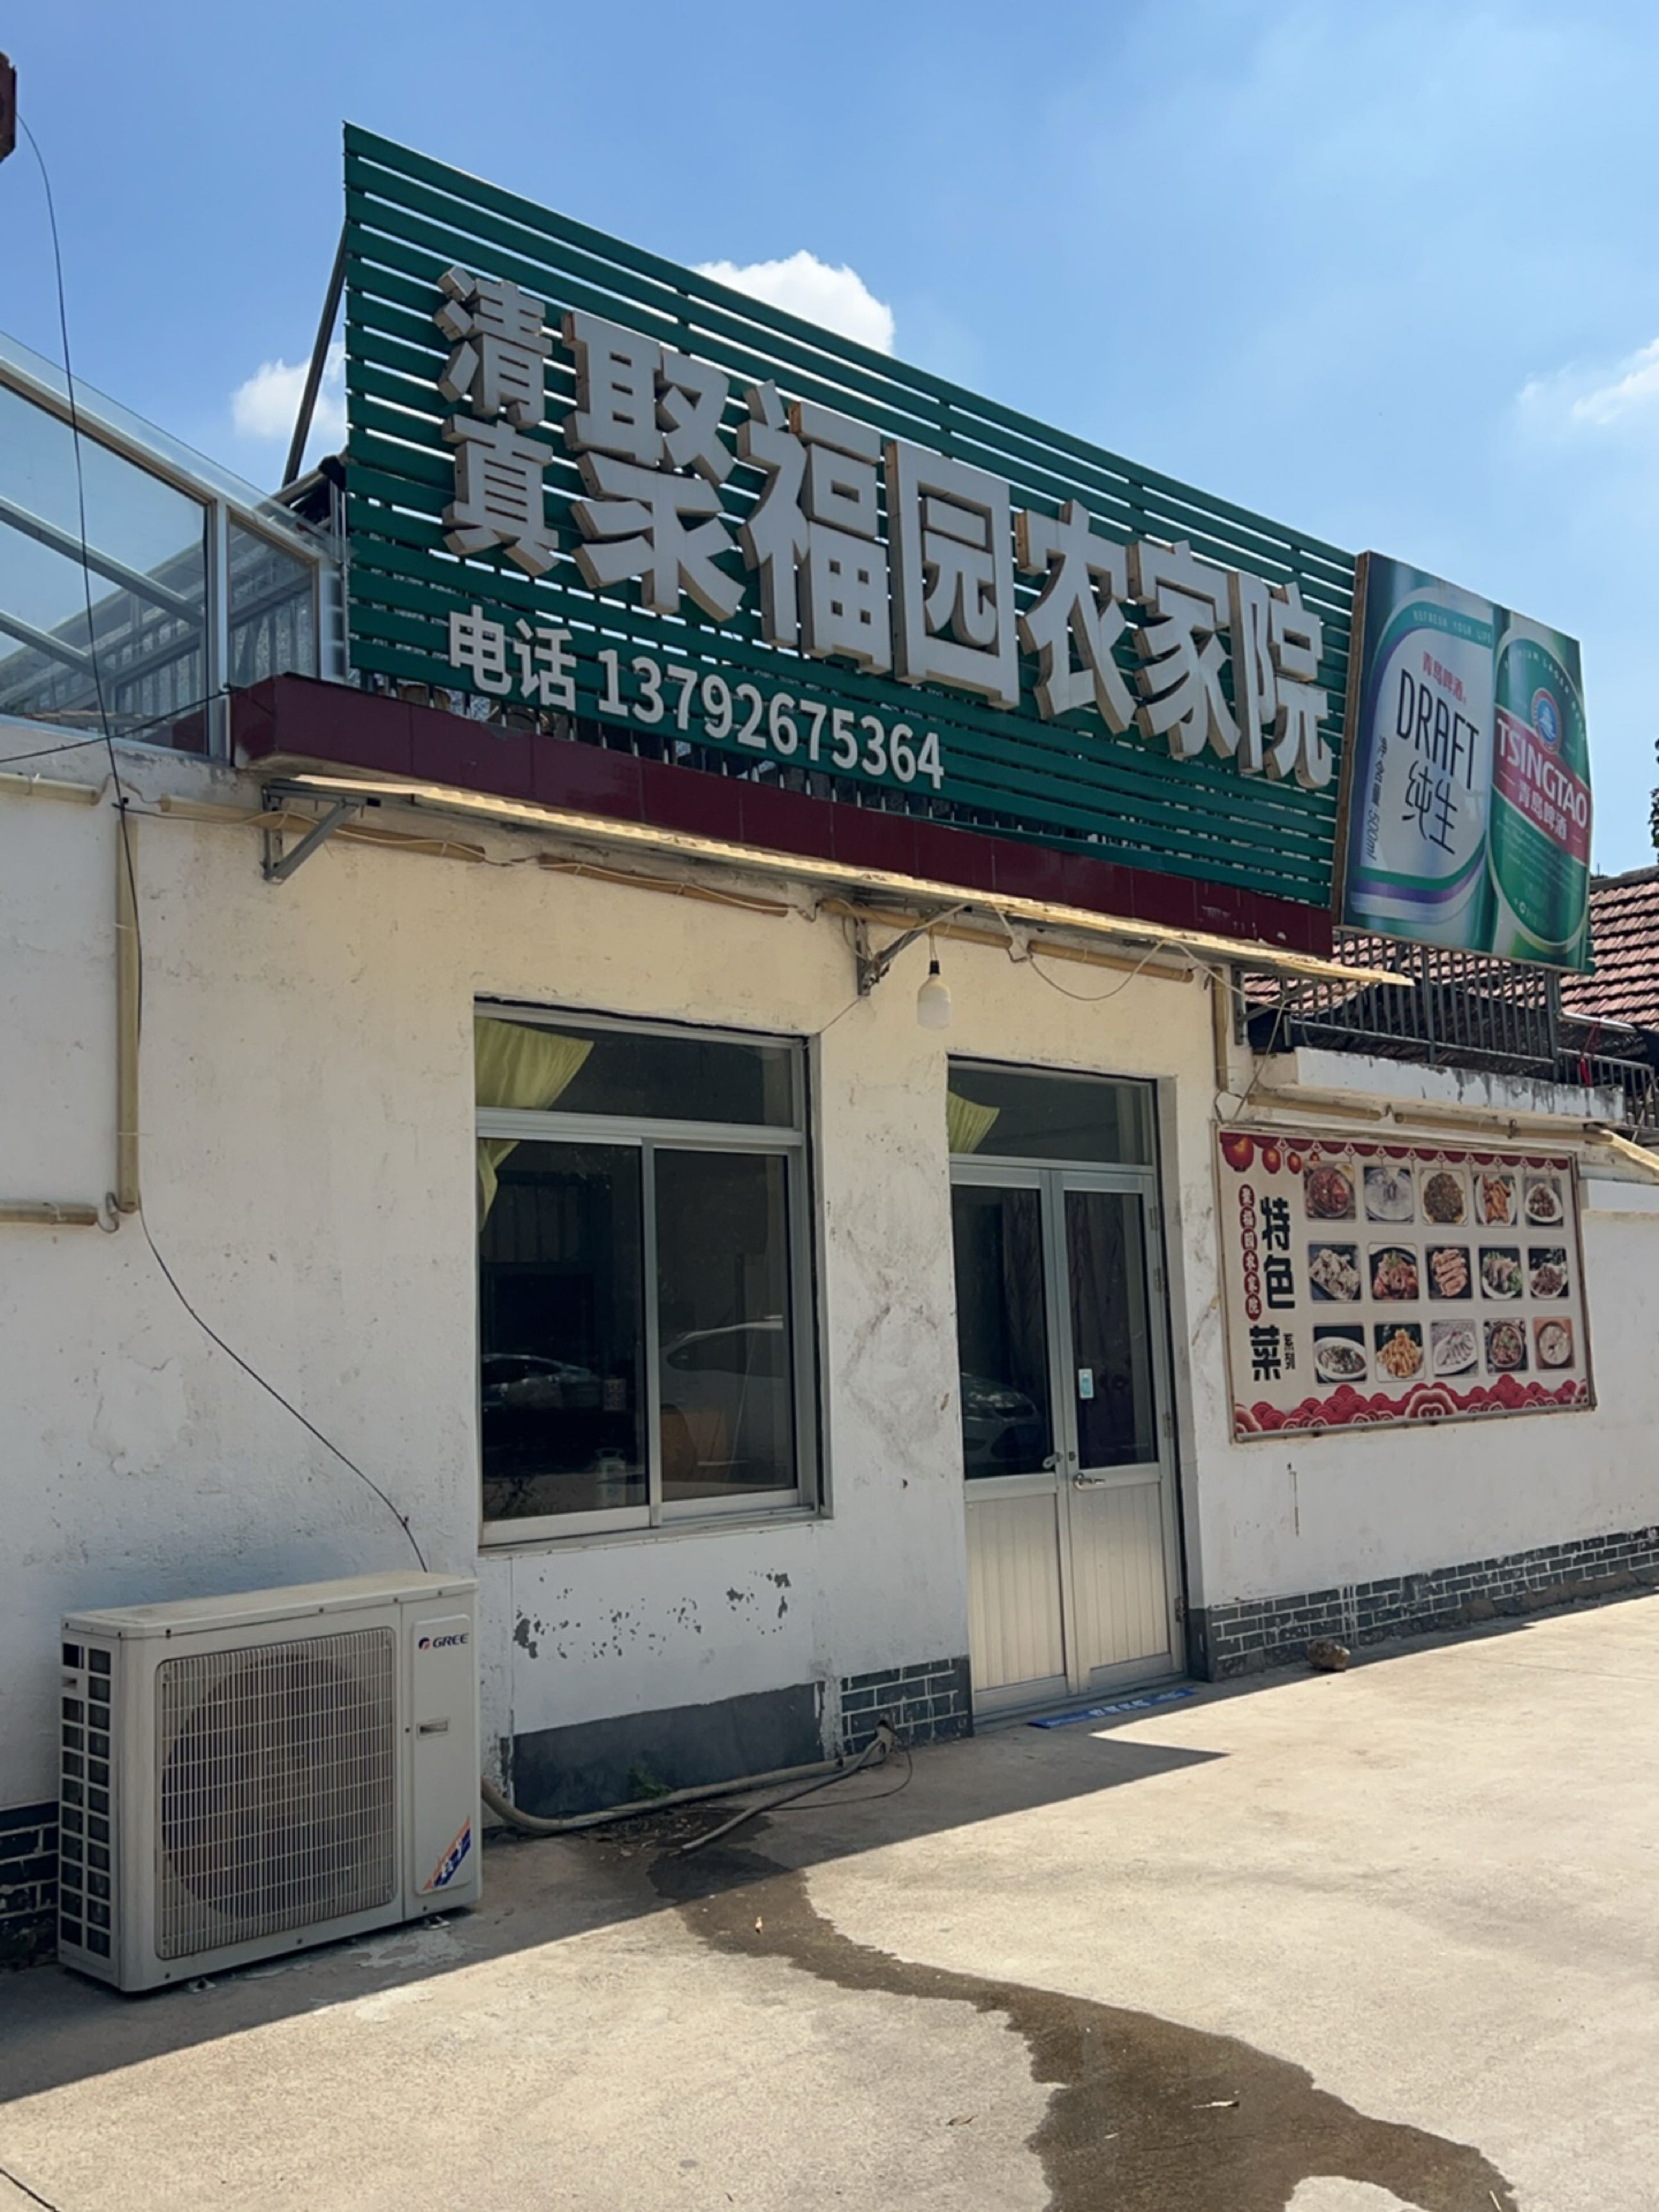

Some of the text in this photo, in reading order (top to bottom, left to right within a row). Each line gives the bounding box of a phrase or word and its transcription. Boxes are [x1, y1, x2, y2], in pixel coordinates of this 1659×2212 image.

[433, 266, 559, 577] 清真
[561, 310, 1332, 790] 聚福园农家院
[449, 604, 945, 790] 电话 13792675364
[1397, 668, 1480, 791] DRAFT
[1402, 760, 1455, 855] 纯生
[1497, 717, 1587, 830] TSINGTAO
[1519, 778, 1567, 841] 青岛啤酒
[433, 1633, 470, 1649] GREE
